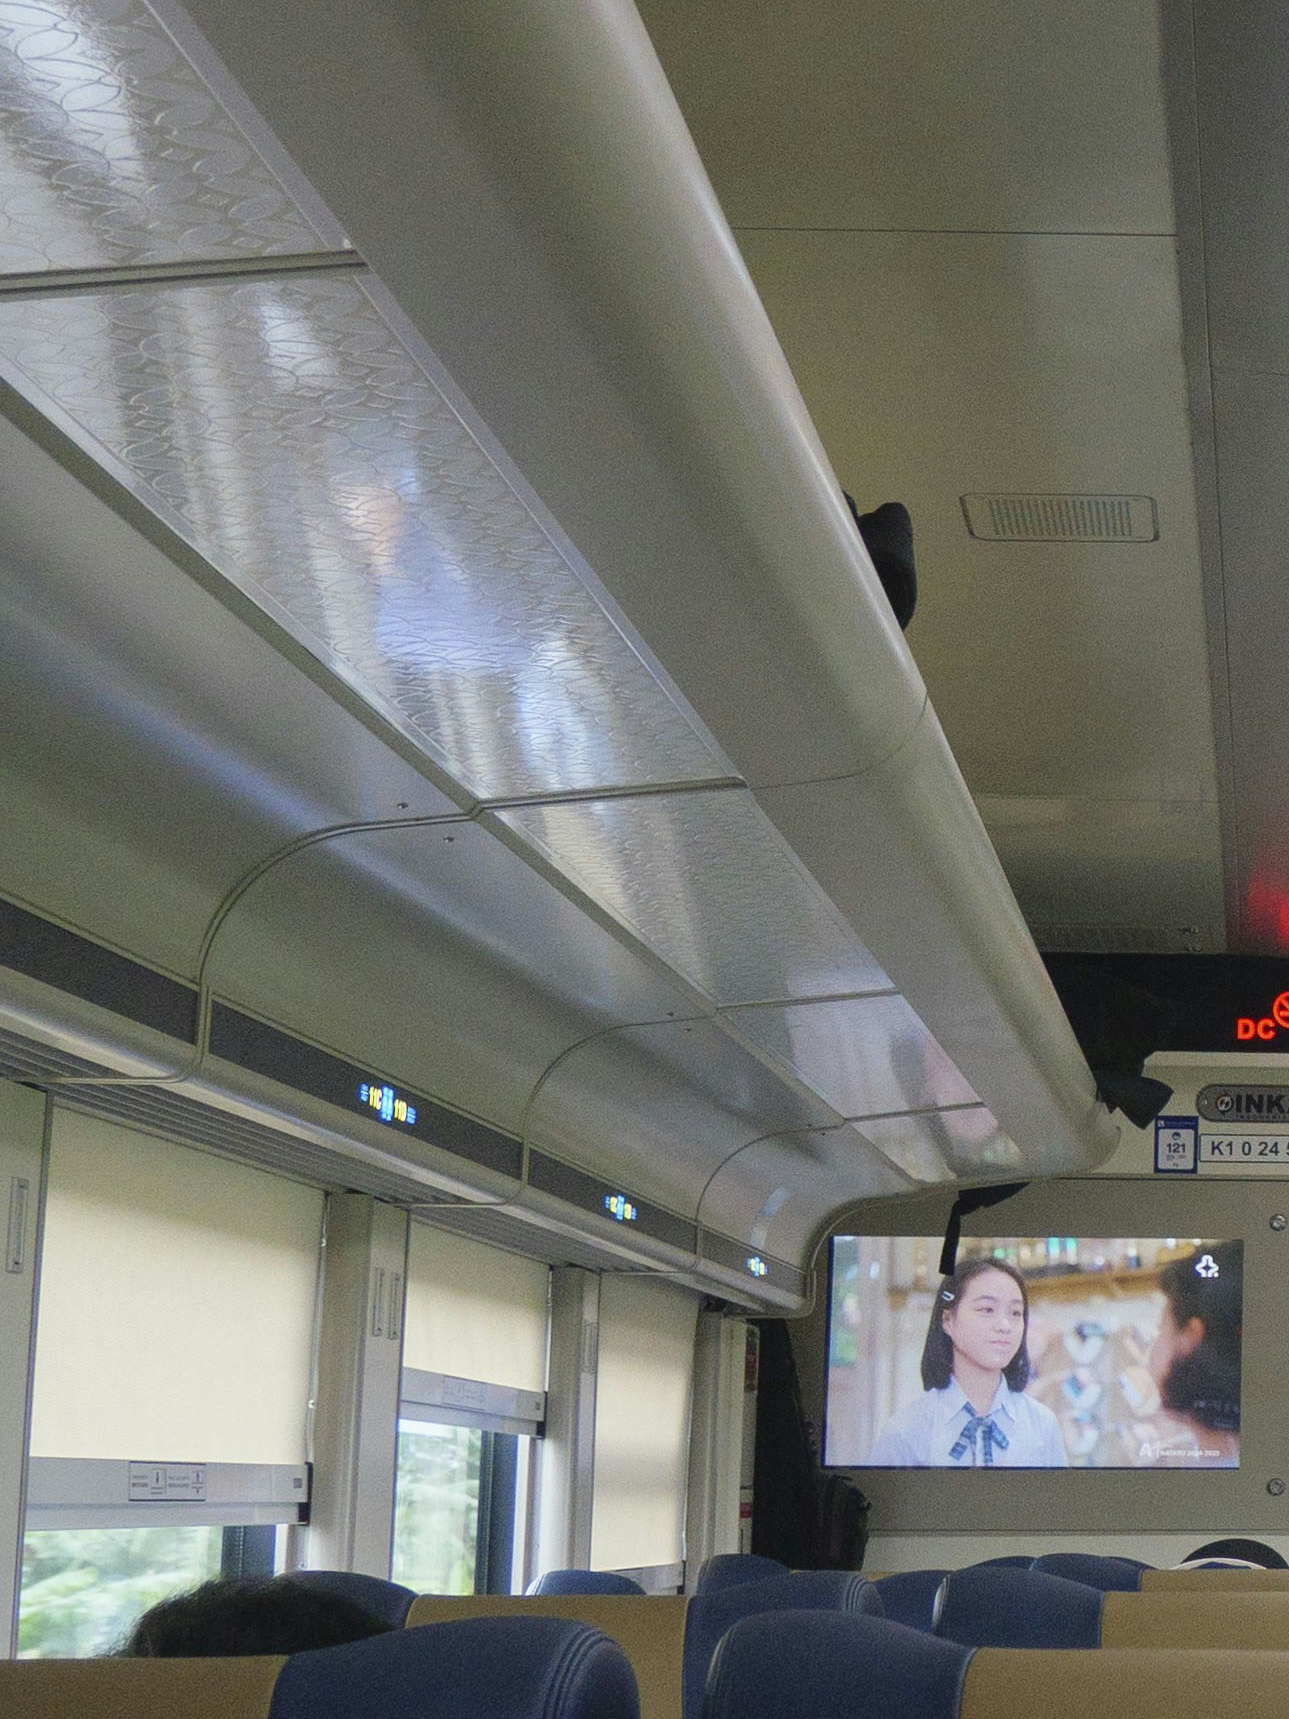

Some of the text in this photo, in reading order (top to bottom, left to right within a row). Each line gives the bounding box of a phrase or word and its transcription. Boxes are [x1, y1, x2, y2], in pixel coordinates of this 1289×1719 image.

[1237, 1018, 1276, 1040] DC
[1166, 1142, 1186, 1154] 121
[1210, 1141, 1234, 1156] K1
[1241, 1141, 1252, 1156] 0
[1258, 1141, 1280, 1156] 24
